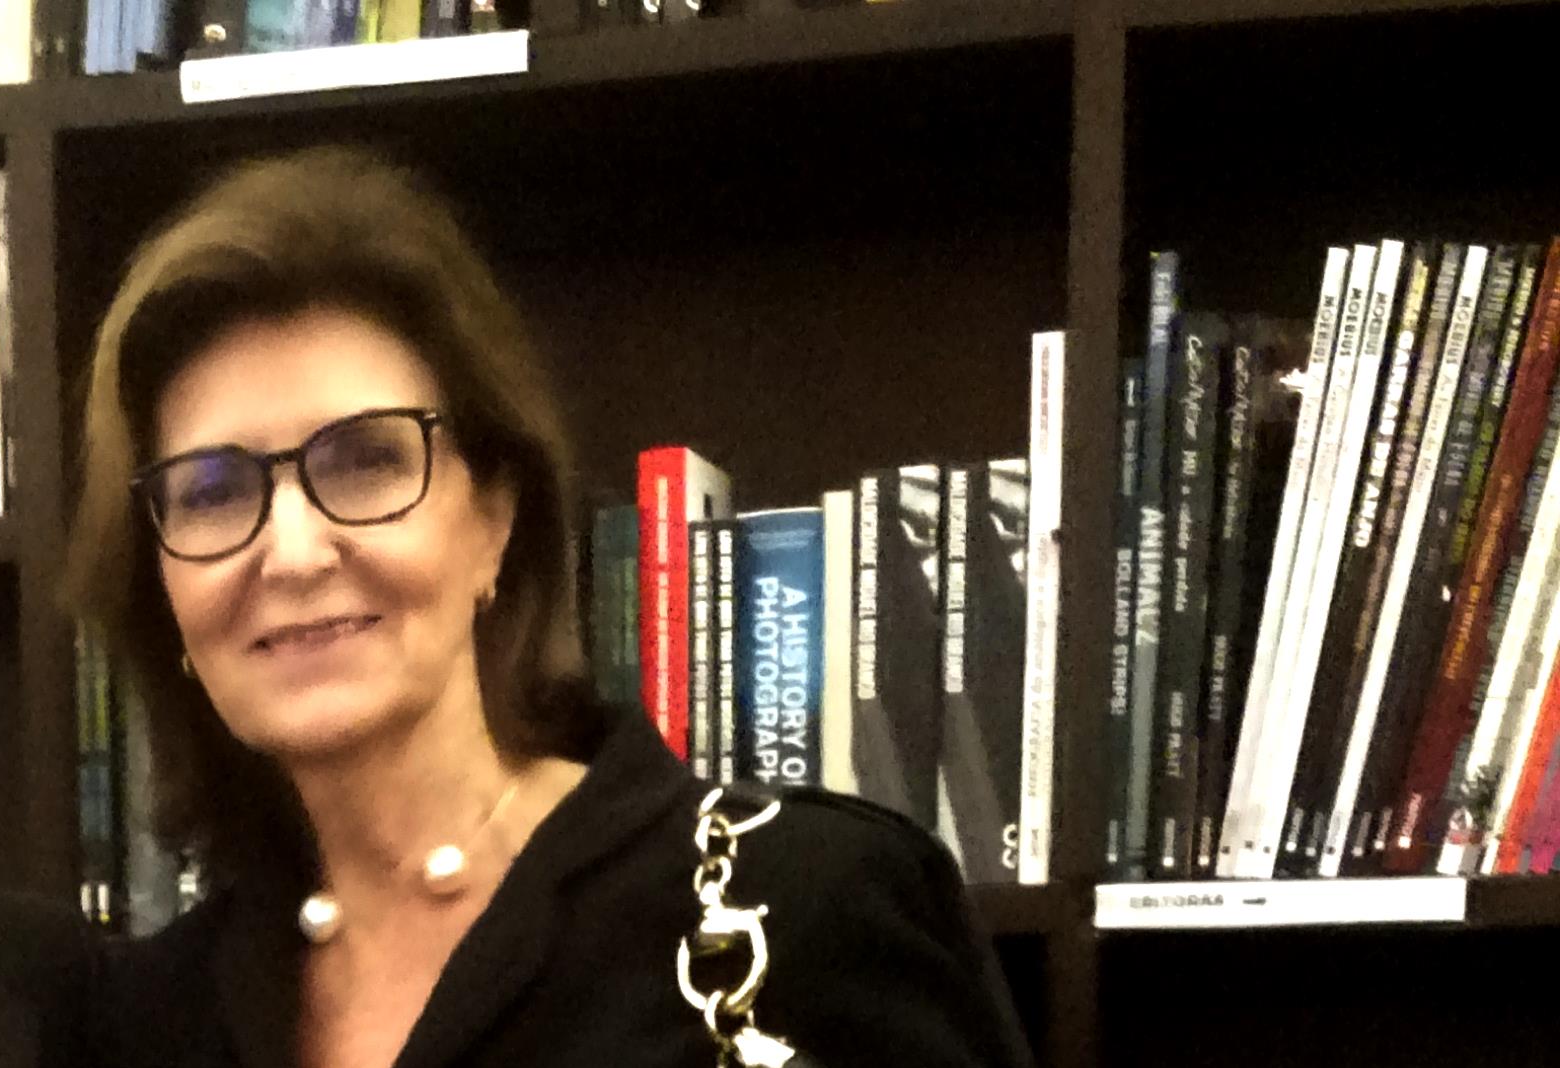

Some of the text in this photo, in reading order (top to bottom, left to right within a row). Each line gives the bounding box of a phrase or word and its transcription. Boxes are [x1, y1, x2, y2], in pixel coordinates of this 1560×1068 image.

[1311, 295, 1338, 364] MOEBIUS
[1339, 287, 1365, 358] MOEBIUS
[1364, 292, 1390, 356] MOEBIUS
[1445, 296, 1474, 365] MOEBIUS
[1369, 440, 1392, 477] DE
[1353, 482, 1382, 549] ANJO
[1111, 549, 1131, 637] BOLLAND
[780, 586, 808, 787] A HISTORY O
